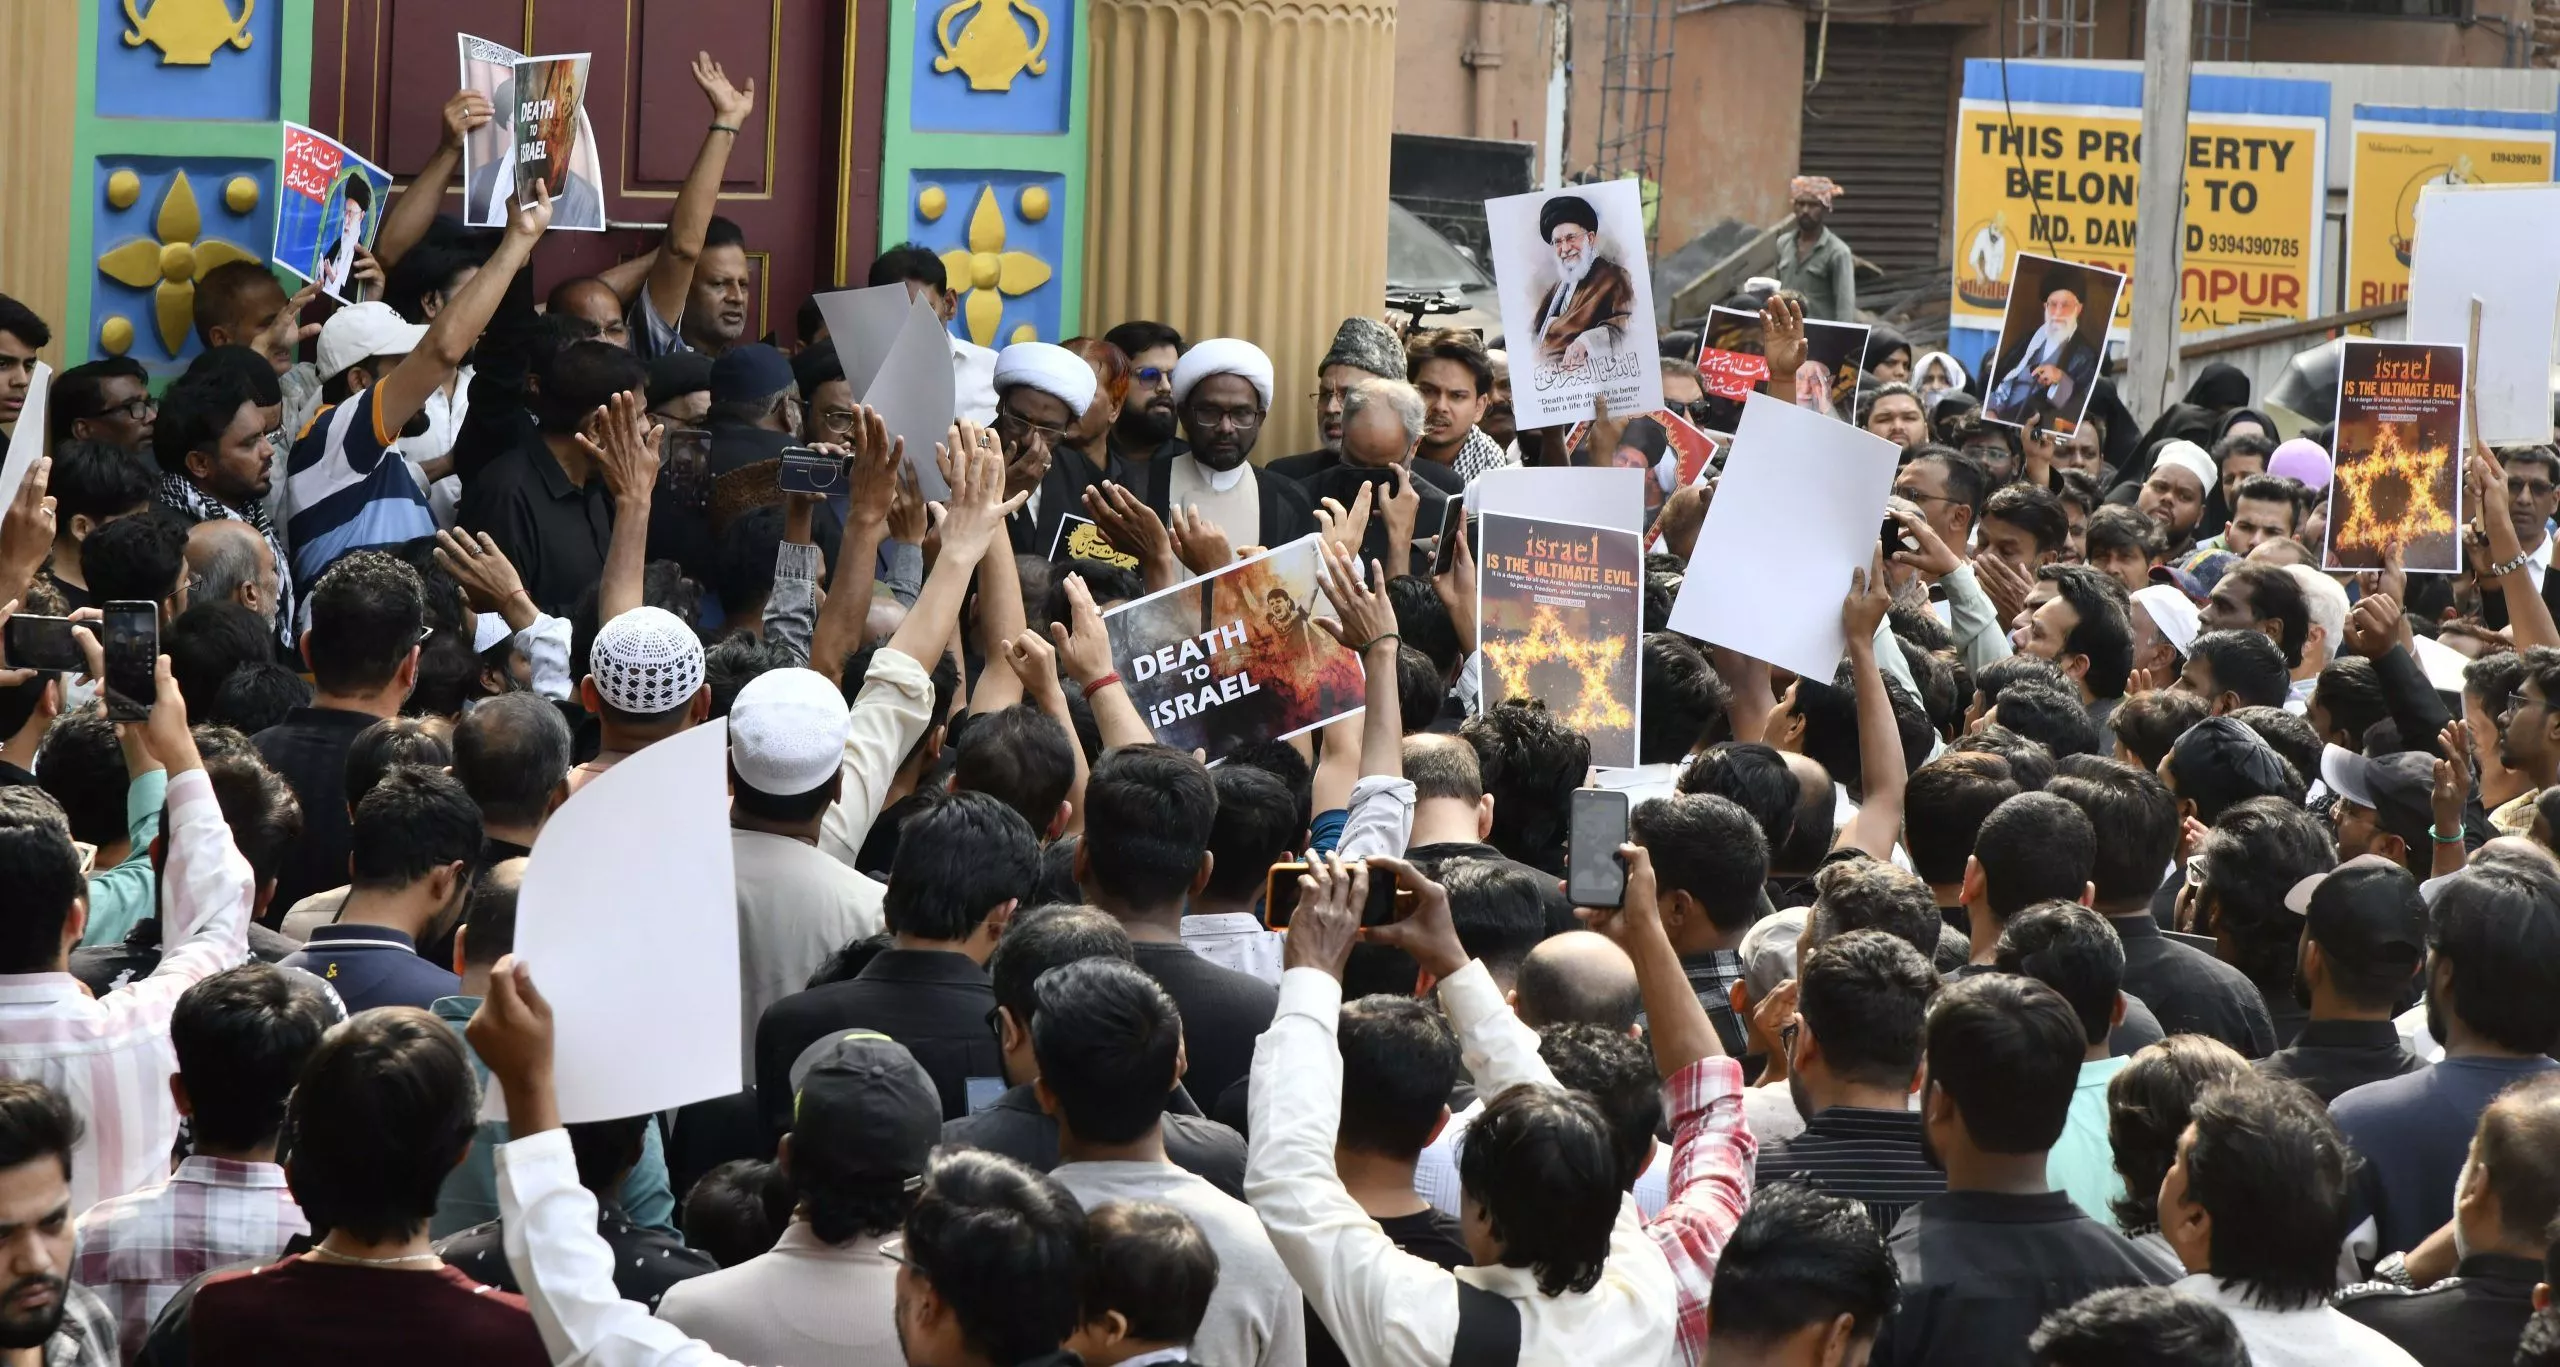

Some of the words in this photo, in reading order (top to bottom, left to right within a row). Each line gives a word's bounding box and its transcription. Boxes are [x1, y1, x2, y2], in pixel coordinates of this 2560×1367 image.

[521, 100, 555, 123] DEATH
[529, 124, 538, 137] TO
[1976, 124, 2063, 160] THIS
[2079, 129, 2295, 172] PRERTY
[2204, 180, 2257, 214] TO
[2030, 214, 2075, 243] MD.
[2086, 218, 2203, 252] DAWD
[2209, 234, 2298, 257] 9394390785
[2374, 349, 2431, 380] israel
[1566, 391, 1583, 402] with
[1584, 389, 1610, 400] dignity
[1619, 385, 1640, 394] better
[2344, 381, 2355, 395] IS
[2359, 381, 2377, 396] THE
[2380, 382, 2429, 397] ULTIMATE
[2433, 383, 2460, 398] EVIL.
[1542, 403, 1560, 414] than
[1569, 401, 1581, 411] life
[1583, 399, 1591, 408] of
[1525, 525, 1598, 564] israel
[1486, 553, 1499, 569] IS
[1504, 556, 1529, 574] THE
[1534, 561, 1598, 582] ULTIMATE
[1604, 569, 1637, 587] EVIL.
[1571, 589, 1590, 597] human
[1132, 619, 1248, 682] DEATH
[1181, 664, 1210, 685] TO
